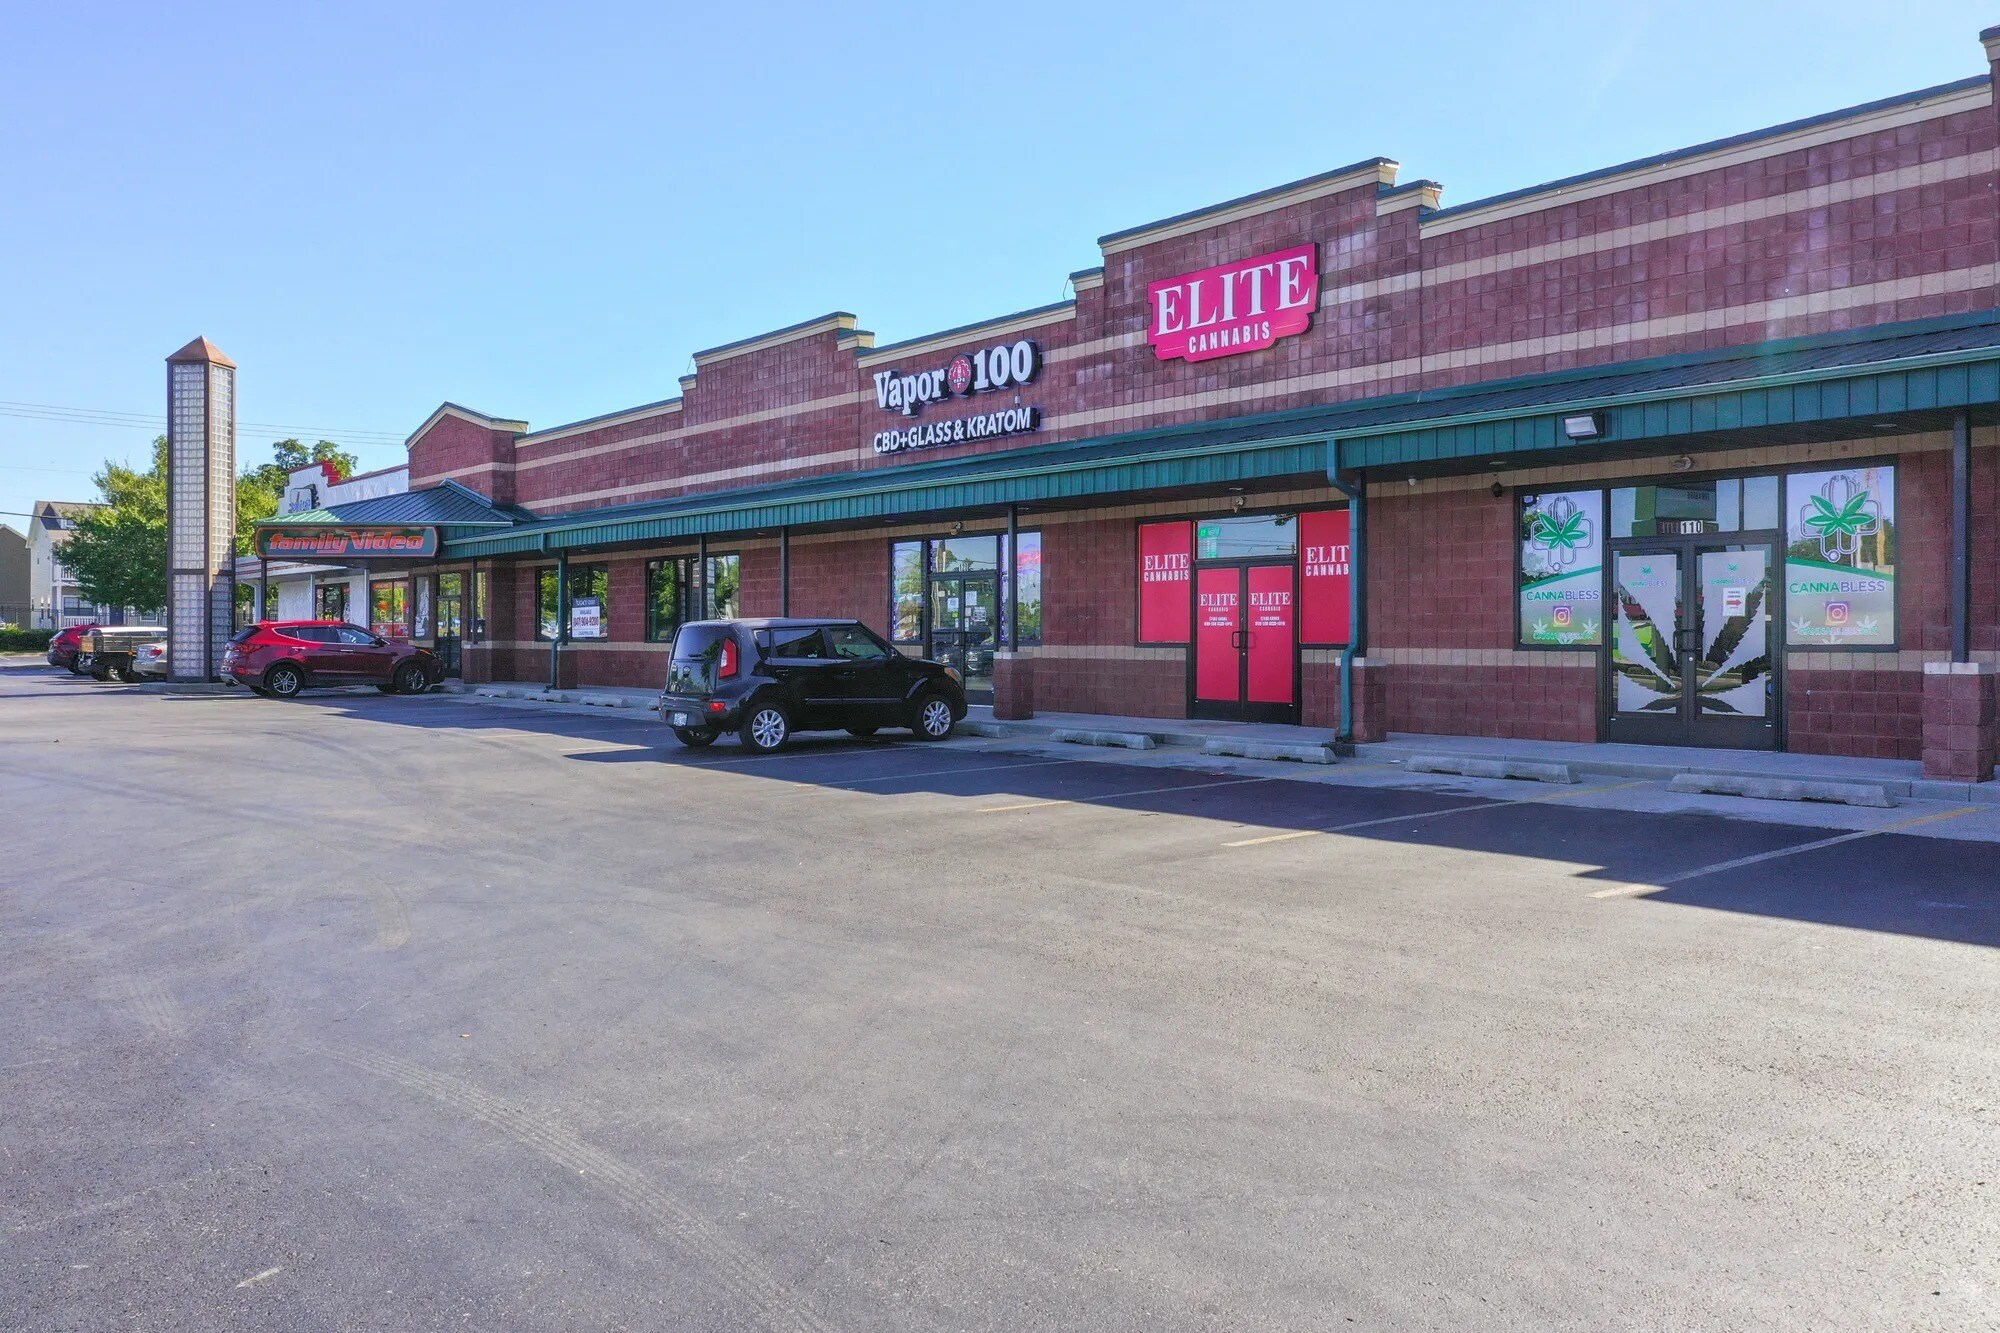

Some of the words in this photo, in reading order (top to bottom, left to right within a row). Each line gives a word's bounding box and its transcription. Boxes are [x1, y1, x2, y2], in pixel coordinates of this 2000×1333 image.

[1154, 255, 1310, 337] ELITE
[1188, 321, 1270, 354] CANNABIS
[873, 368, 945, 416] Vapor
[973, 340, 1033, 391] 100
[873, 420, 952, 453] CBD+GLASS
[953, 419, 965, 441] &
[966, 407, 1031, 438] KRATOM
[269, 532, 348, 554] family
[344, 531, 424, 550] Video
[1143, 553, 1189, 571] ELITE
[1305, 545, 1350, 564] ELIT
[1143, 571, 1190, 583] CANNABIS
[1305, 563, 1349, 577] CANNAB
[1526, 590, 1599, 601] CANNABLESS
[1789, 580, 1886, 594] CANNABLESS
[1200, 593, 1237, 606] ELITE
[1250, 592, 1290, 605] ELITE
